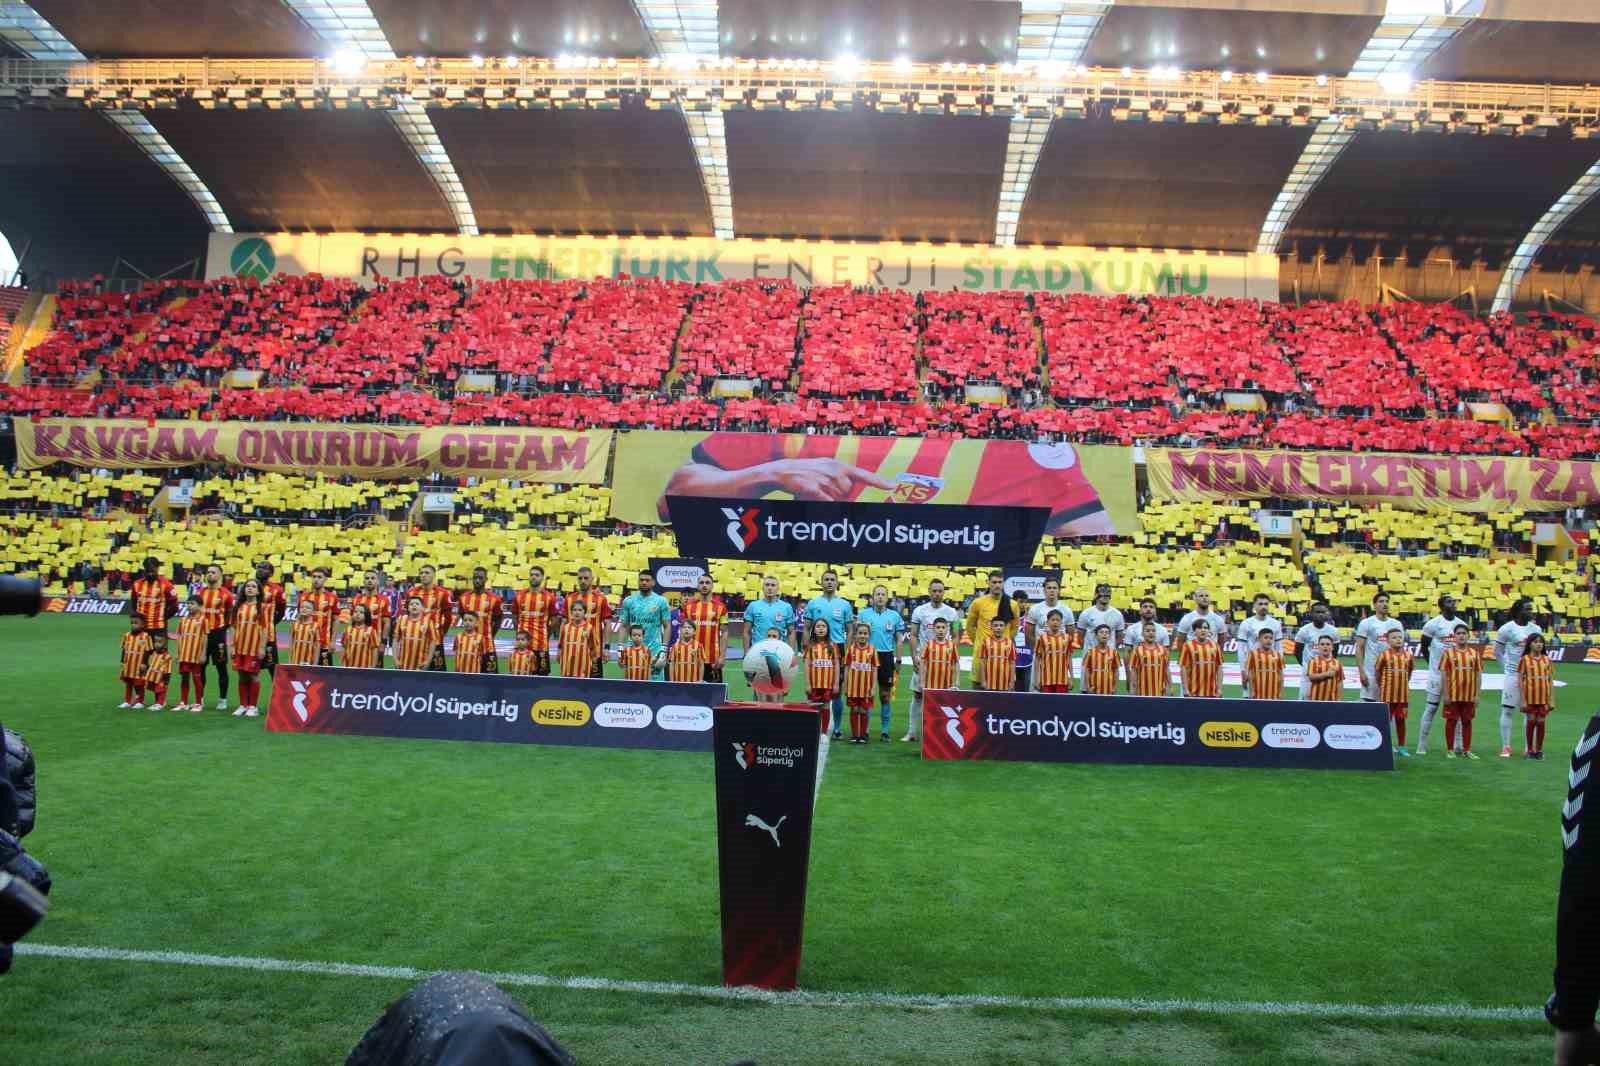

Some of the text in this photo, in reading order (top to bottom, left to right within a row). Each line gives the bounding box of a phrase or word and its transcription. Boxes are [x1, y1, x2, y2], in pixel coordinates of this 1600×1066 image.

[963, 258, 1209, 295] STADYUMU
[440, 433, 590, 472] CEFAM
[765, 515, 996, 551] trendyol SüperLig
[330, 688, 519, 722] trendyol SüperLig
[604, 706, 645, 717] trendyol
[986, 714, 1186, 745] trendyol SüperLig
[1271, 727, 1311, 737] trendyol
[757, 745, 804, 758] trendyol
